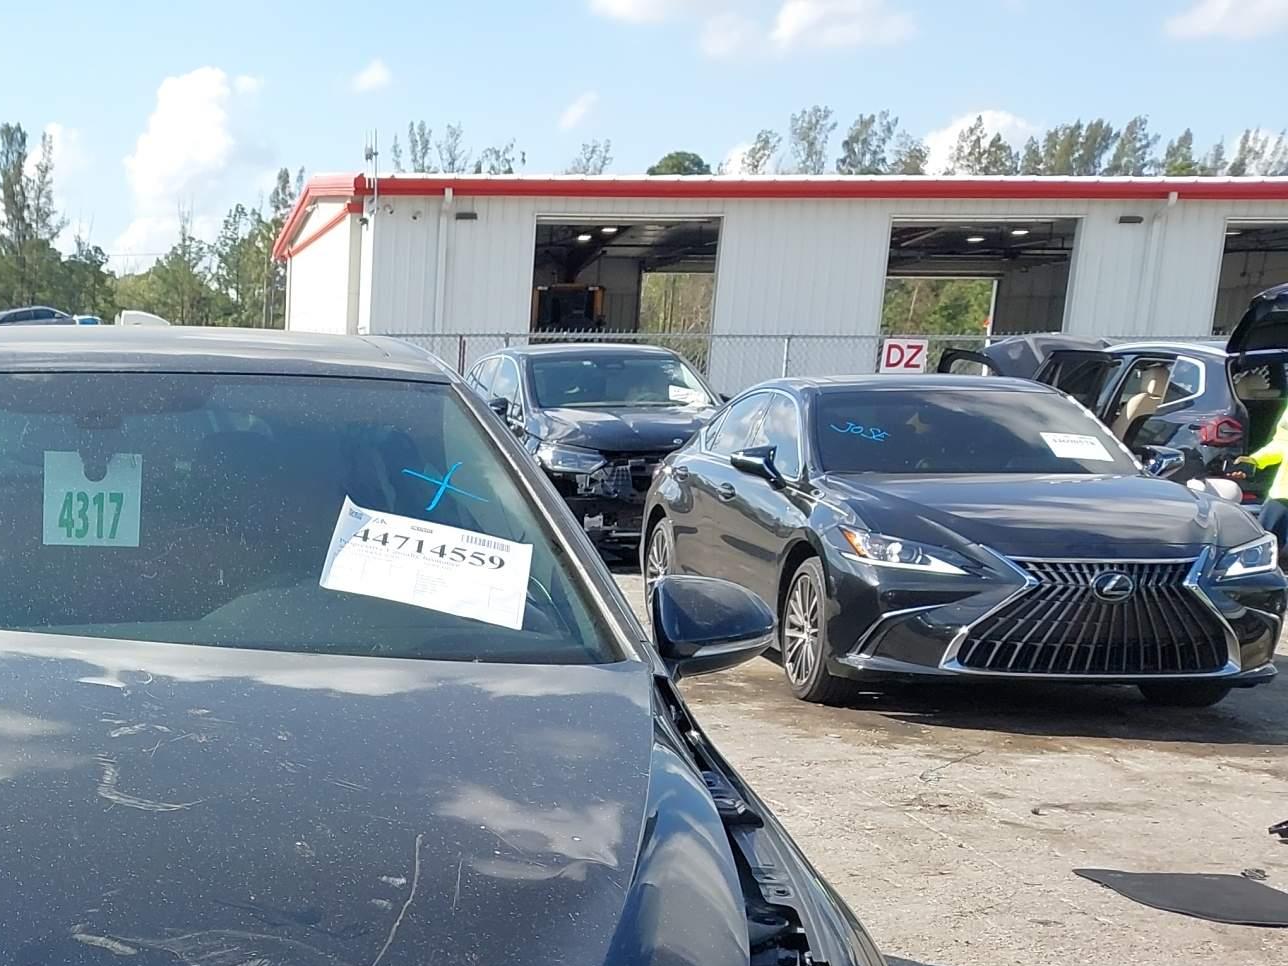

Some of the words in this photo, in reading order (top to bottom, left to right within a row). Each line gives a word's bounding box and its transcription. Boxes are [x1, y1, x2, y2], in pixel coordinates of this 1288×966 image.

[884, 343, 924, 369] DZ
[57, 490, 125, 540] 4317
[352, 528, 506, 570] 44714559
